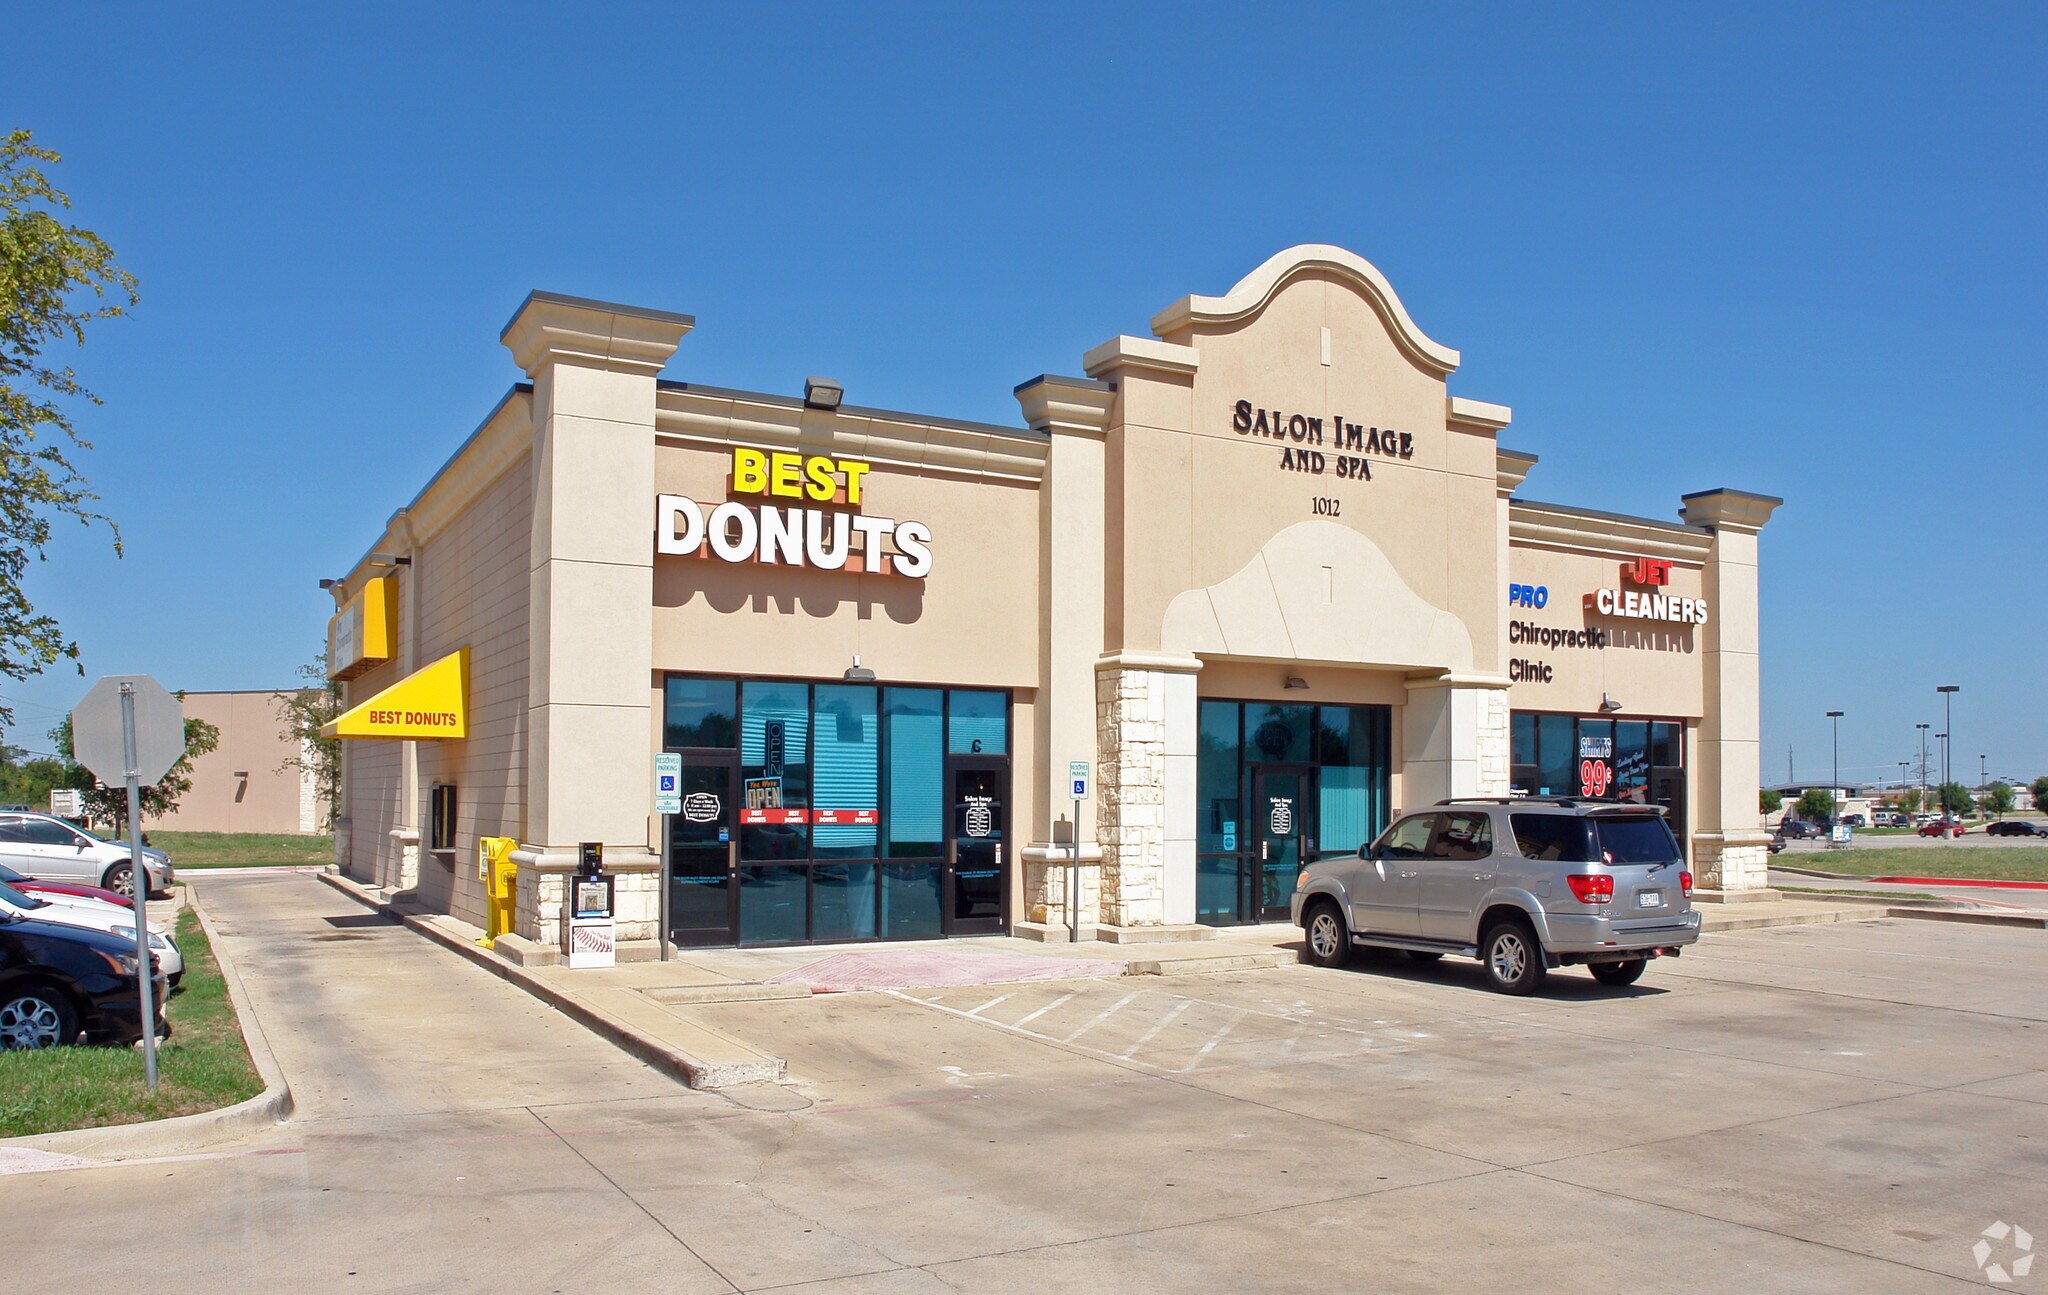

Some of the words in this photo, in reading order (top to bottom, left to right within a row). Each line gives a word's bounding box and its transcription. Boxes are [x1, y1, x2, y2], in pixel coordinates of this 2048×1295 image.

[732, 447, 870, 504] BEST
[1280, 447, 1325, 474] AND
[1336, 455, 1372, 481] SPA
[1311, 496, 1341, 517] 1012
[657, 493, 934, 578] DONUTS
[1634, 557, 1673, 586] JET
[1509, 583, 1548, 609] PRO
[1596, 587, 1709, 625] CLEANERS
[1509, 620, 1605, 651] Chiropractic
[1509, 658, 1553, 684] Clinic
[370, 710, 402, 725] BEST
[405, 711, 456, 727] DONUTS
[770, 724, 781, 775] OPEN
[972, 739, 982, 753] C
[1580, 736, 1611, 758] SHIRTS
[748, 786, 780, 809] OPEN
